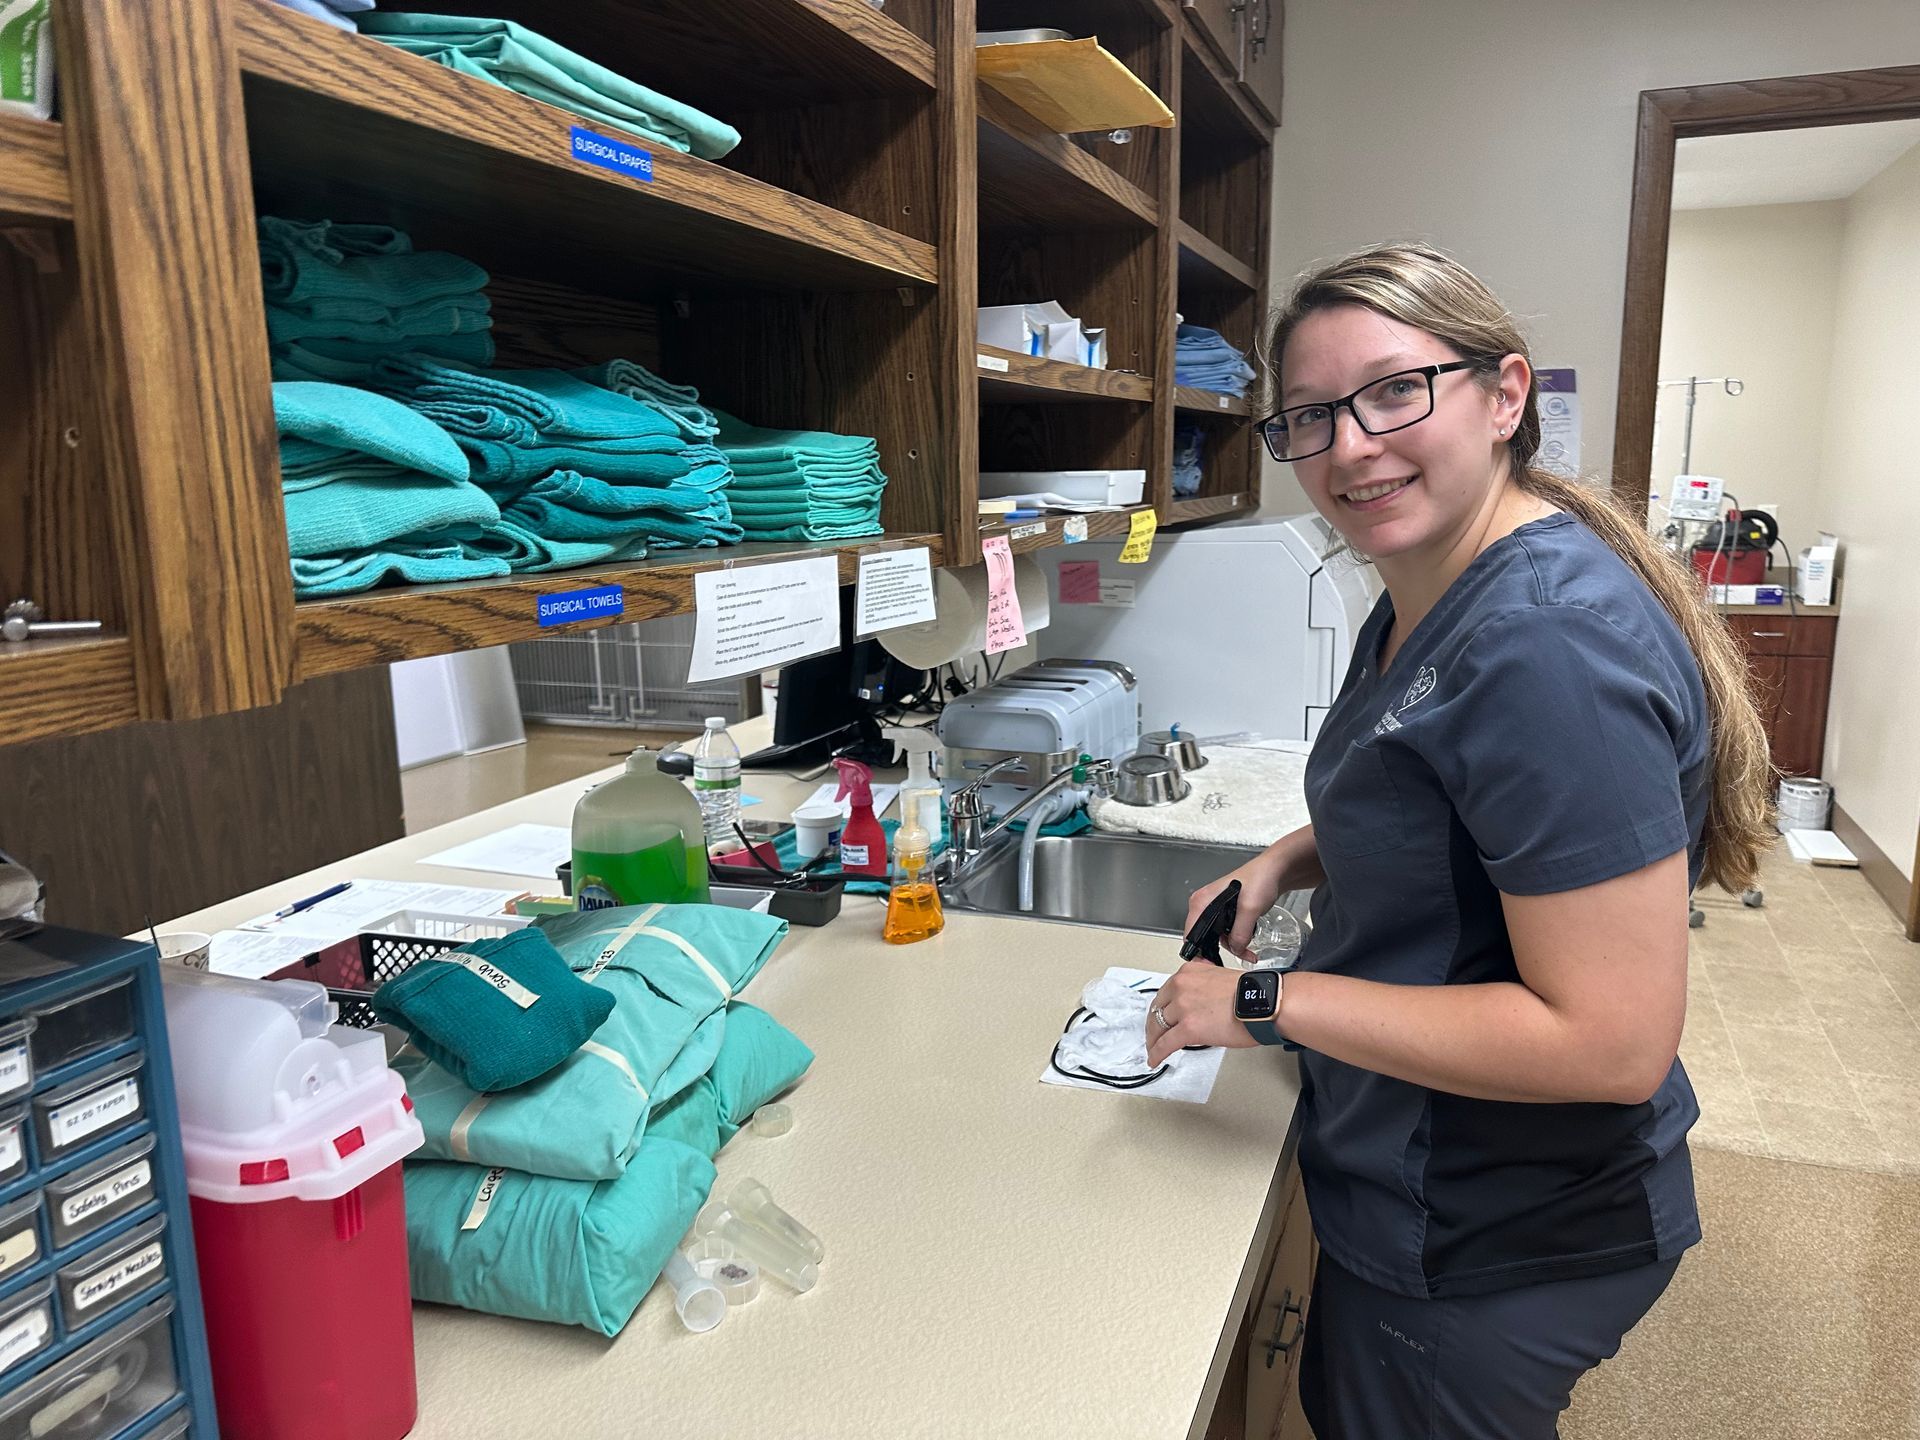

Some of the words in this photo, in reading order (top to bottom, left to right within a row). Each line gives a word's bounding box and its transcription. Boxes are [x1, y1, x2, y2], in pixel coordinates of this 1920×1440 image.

[574, 137, 619, 163] SURGICAL
[619, 152, 652, 173] DRAPES
[540, 600, 586, 617] SURGICAL
[587, 593, 622, 609] TOWELS
[479, 964, 511, 988] Scrub
[112, 1175, 140, 1195] Pins
